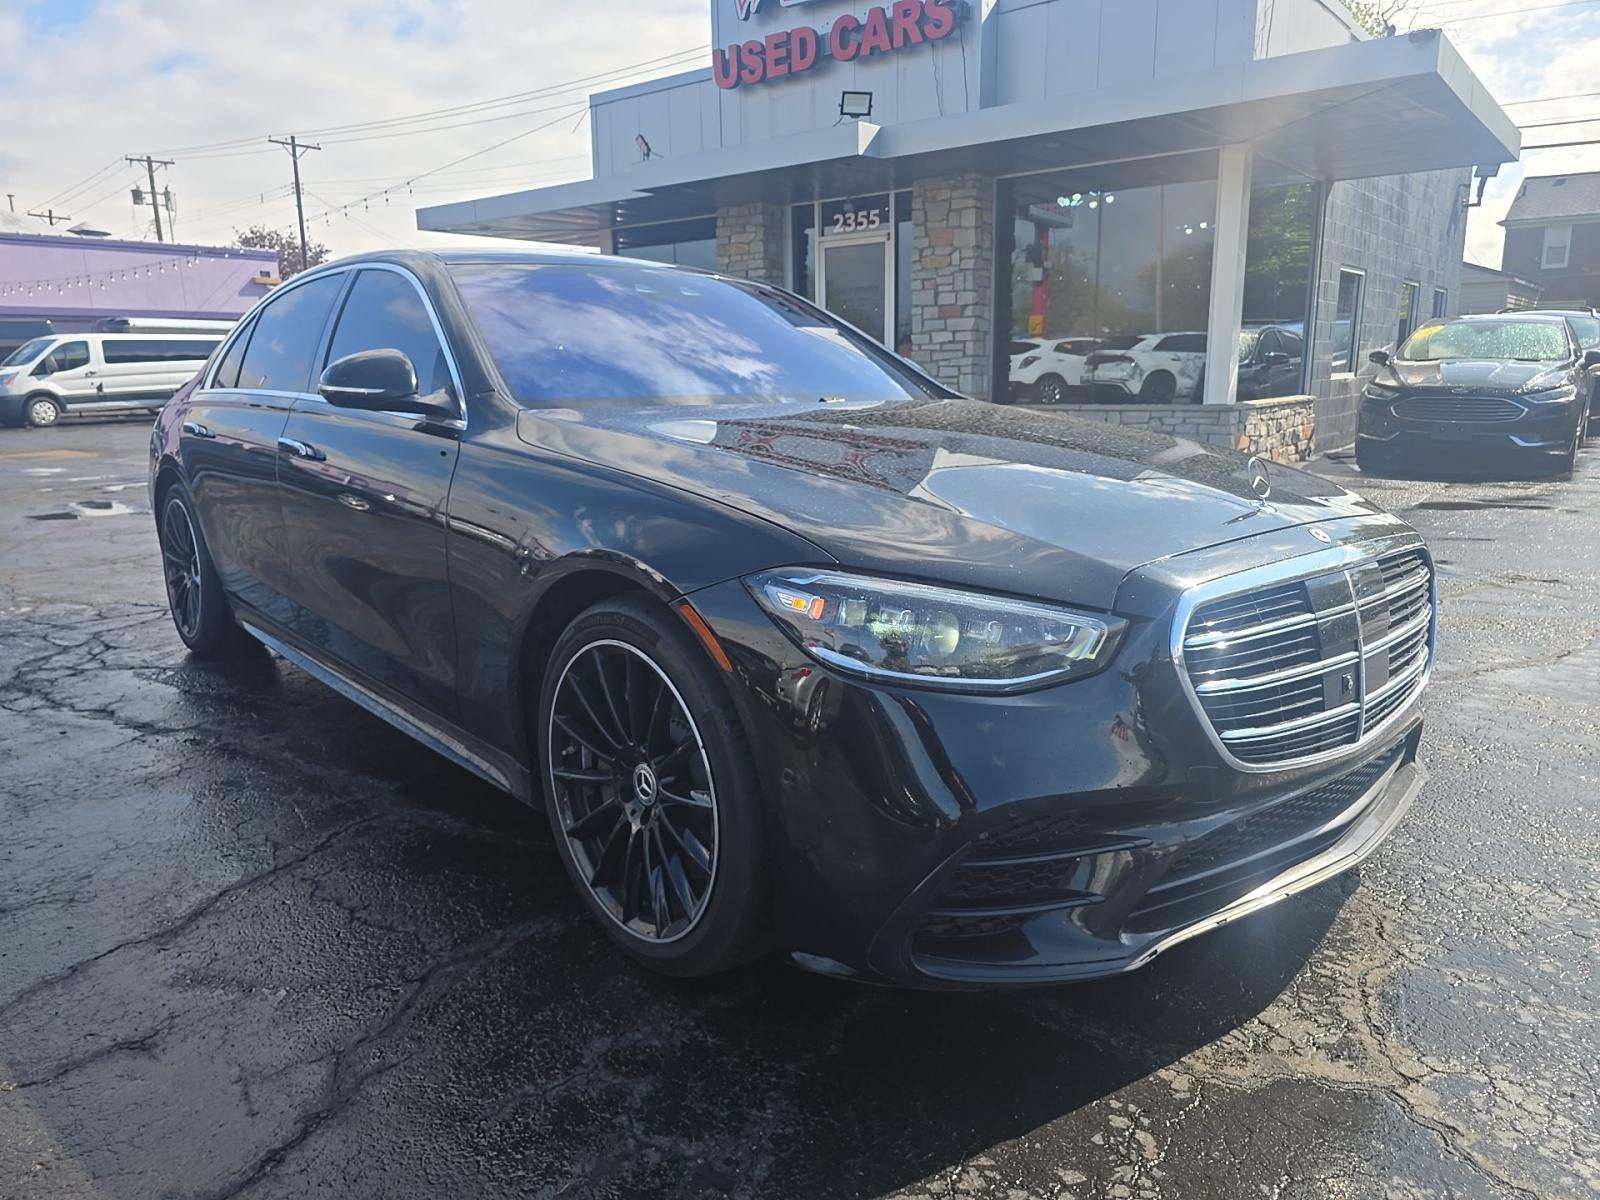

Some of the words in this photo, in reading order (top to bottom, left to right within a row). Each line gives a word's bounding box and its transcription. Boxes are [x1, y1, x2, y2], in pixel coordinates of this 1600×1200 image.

[712, 27, 818, 89] USED
[830, 0, 954, 61] CARS
[833, 209, 880, 233] 2355
